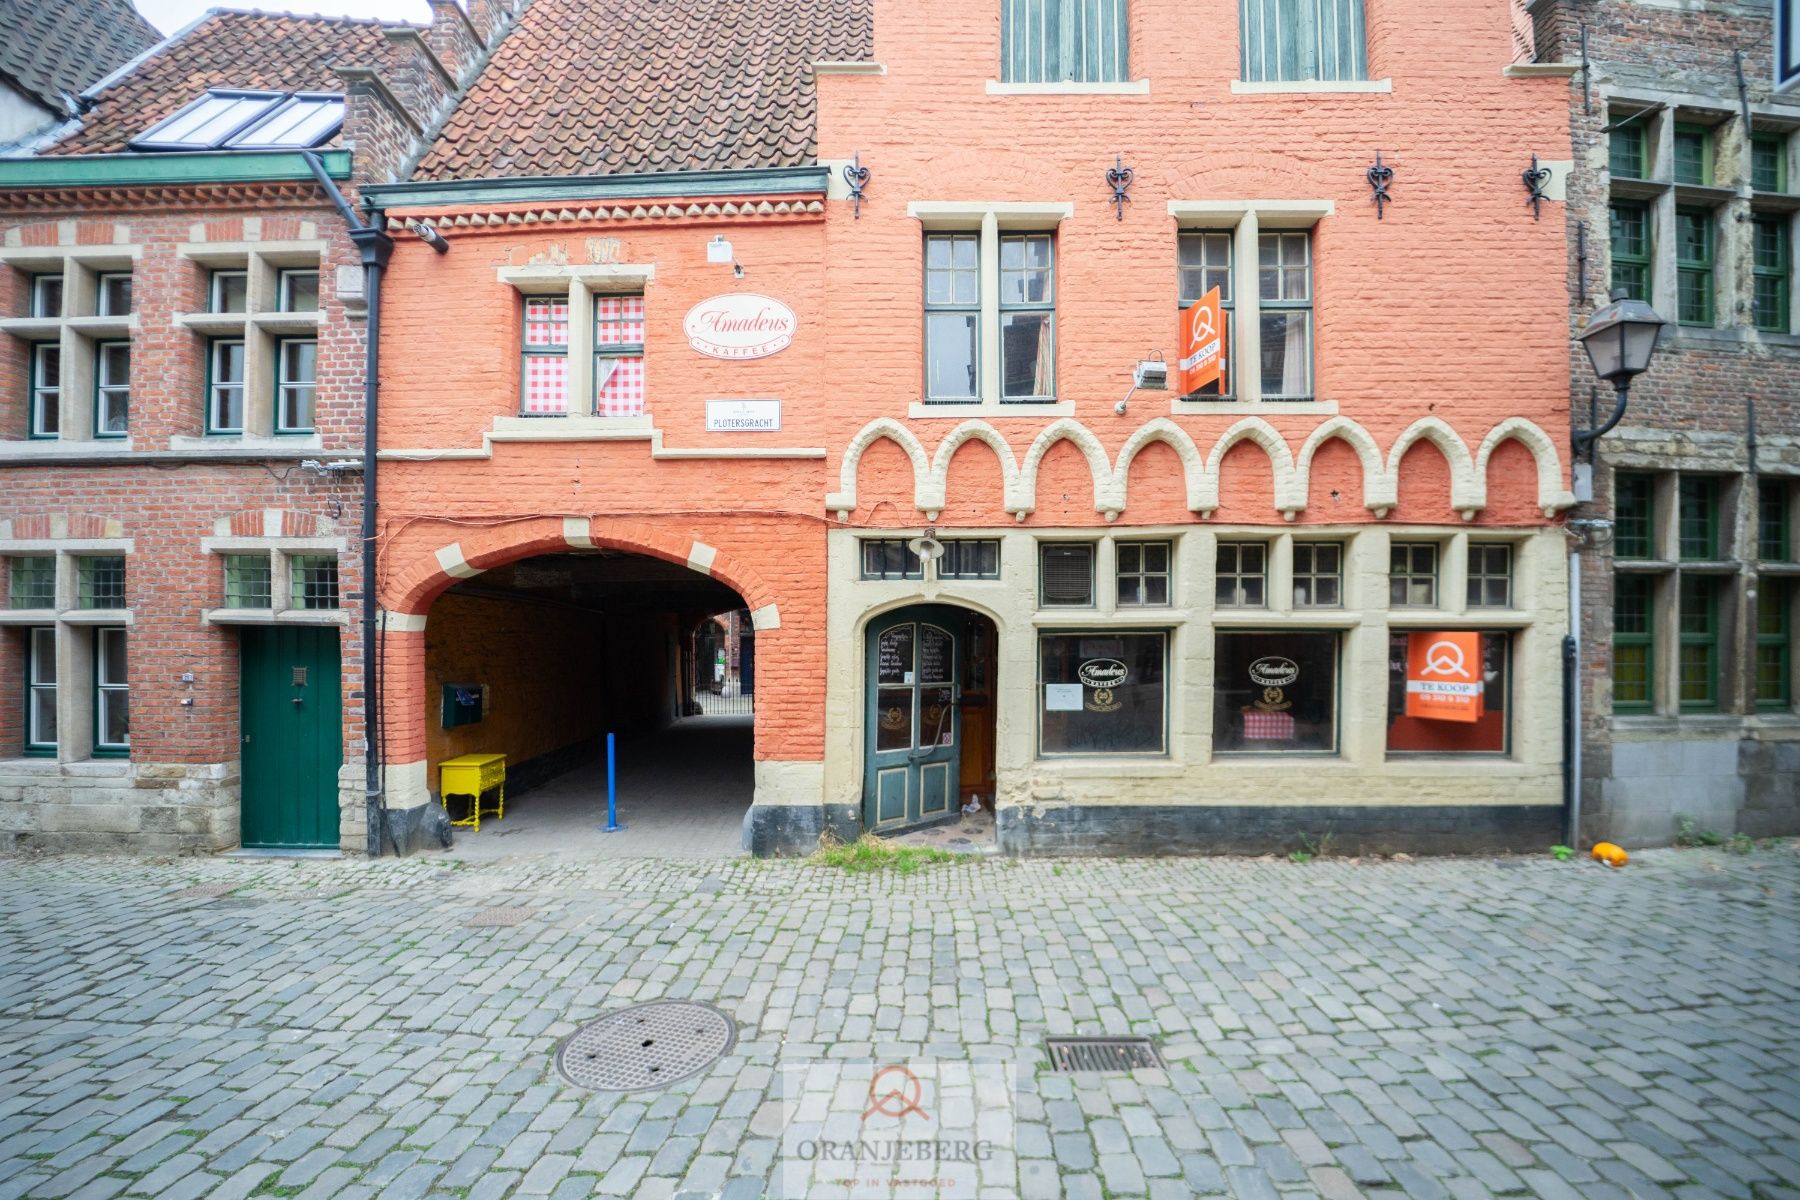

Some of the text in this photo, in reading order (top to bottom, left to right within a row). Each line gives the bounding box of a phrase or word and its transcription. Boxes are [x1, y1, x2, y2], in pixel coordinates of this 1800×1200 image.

[691, 306, 789, 334] Amadeus
[712, 344, 768, 356] KAFFEE
[1199, 342, 1216, 358] KOOP
[713, 418, 773, 428] PLOTERSGRACHT
[1081, 663, 1125, 677] Amadeus
[1421, 682, 1470, 692] TE KOOP
